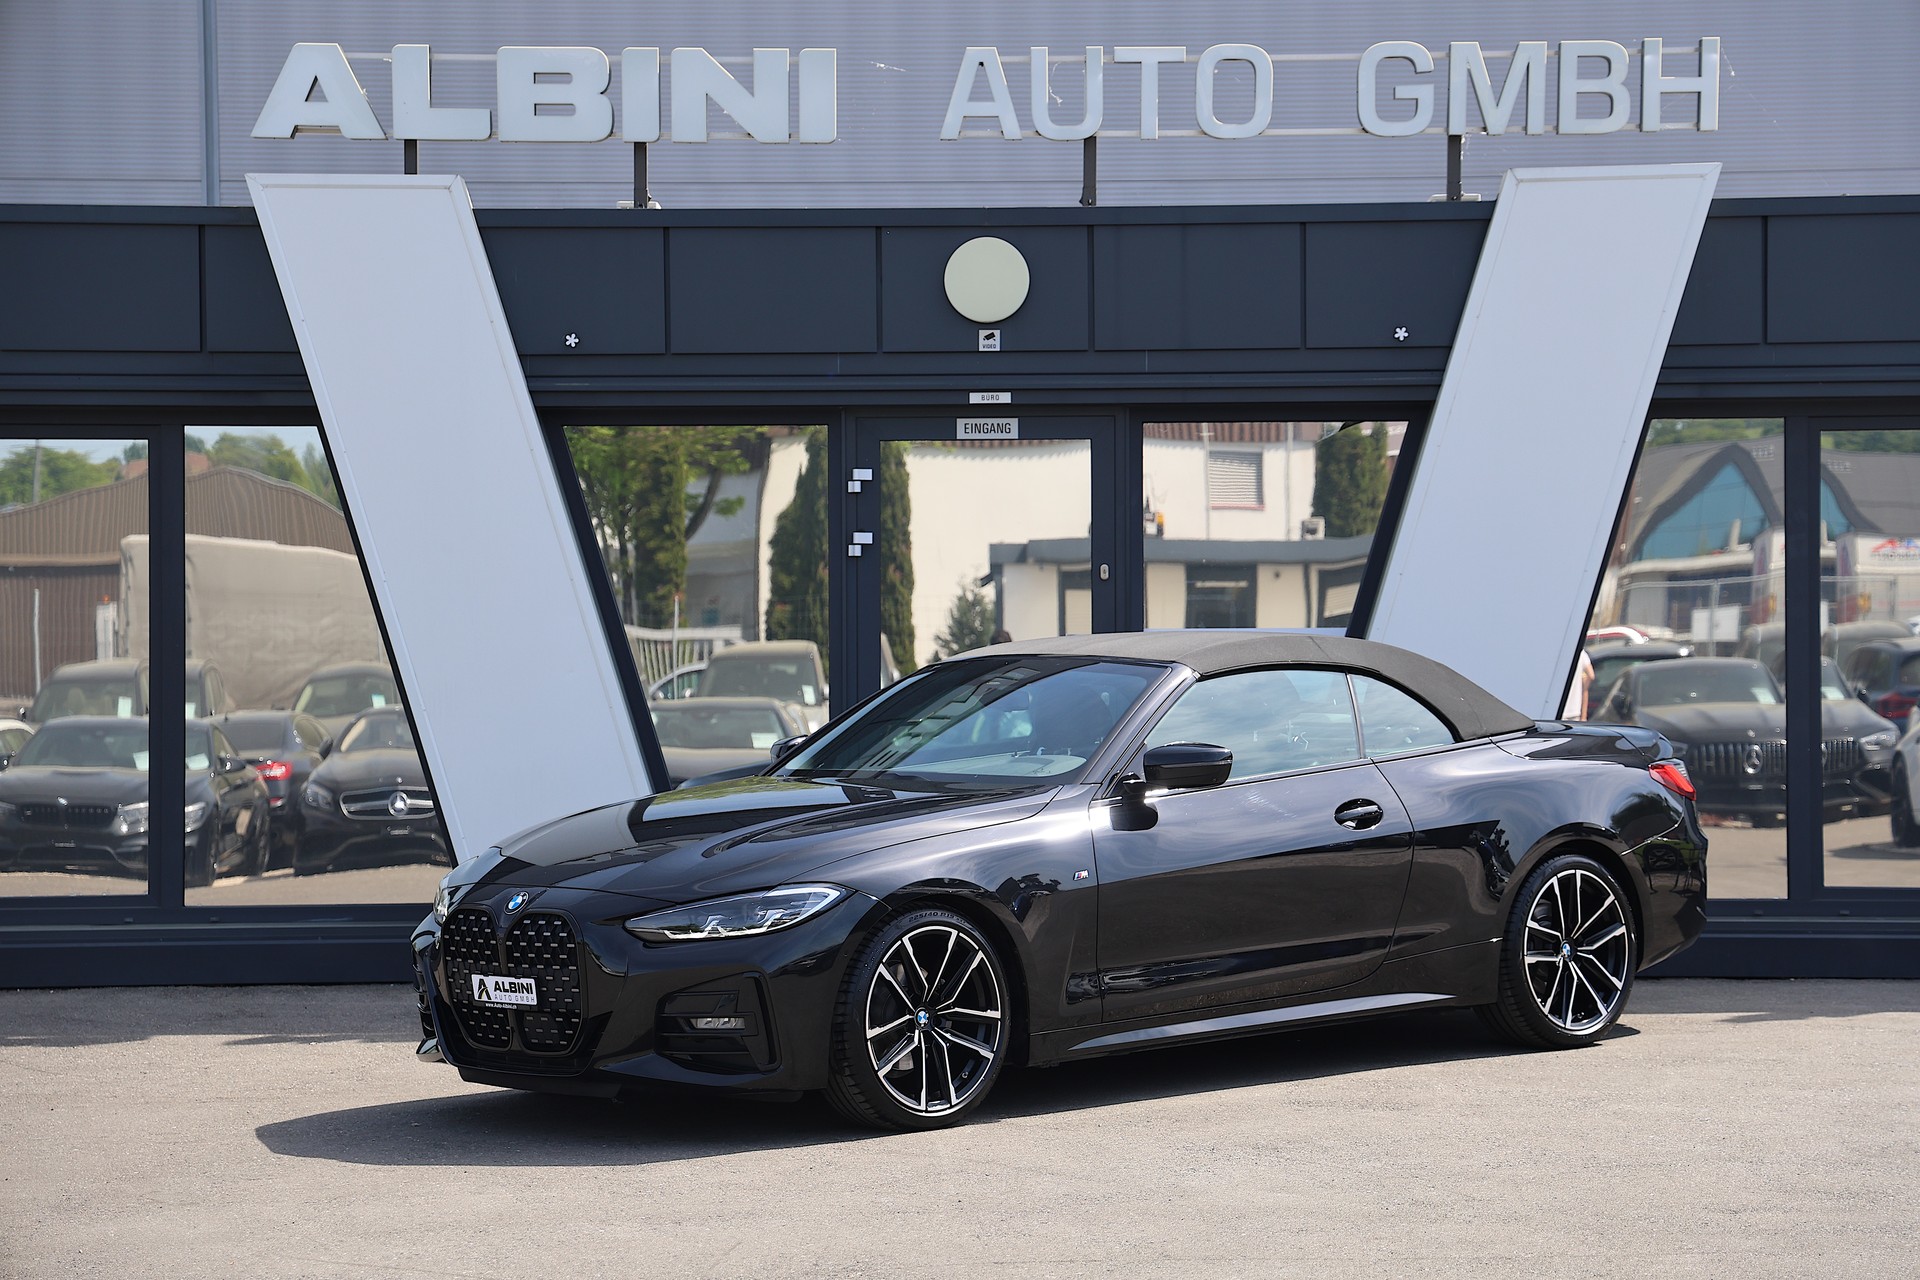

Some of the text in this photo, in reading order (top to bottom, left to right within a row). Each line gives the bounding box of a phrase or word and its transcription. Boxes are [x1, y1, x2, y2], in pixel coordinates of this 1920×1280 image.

[250, 36, 1721, 144] ALBINI AUTO GMBH
[964, 423, 1011, 434] EINGANG
[494, 981, 533, 994] ALBINI
